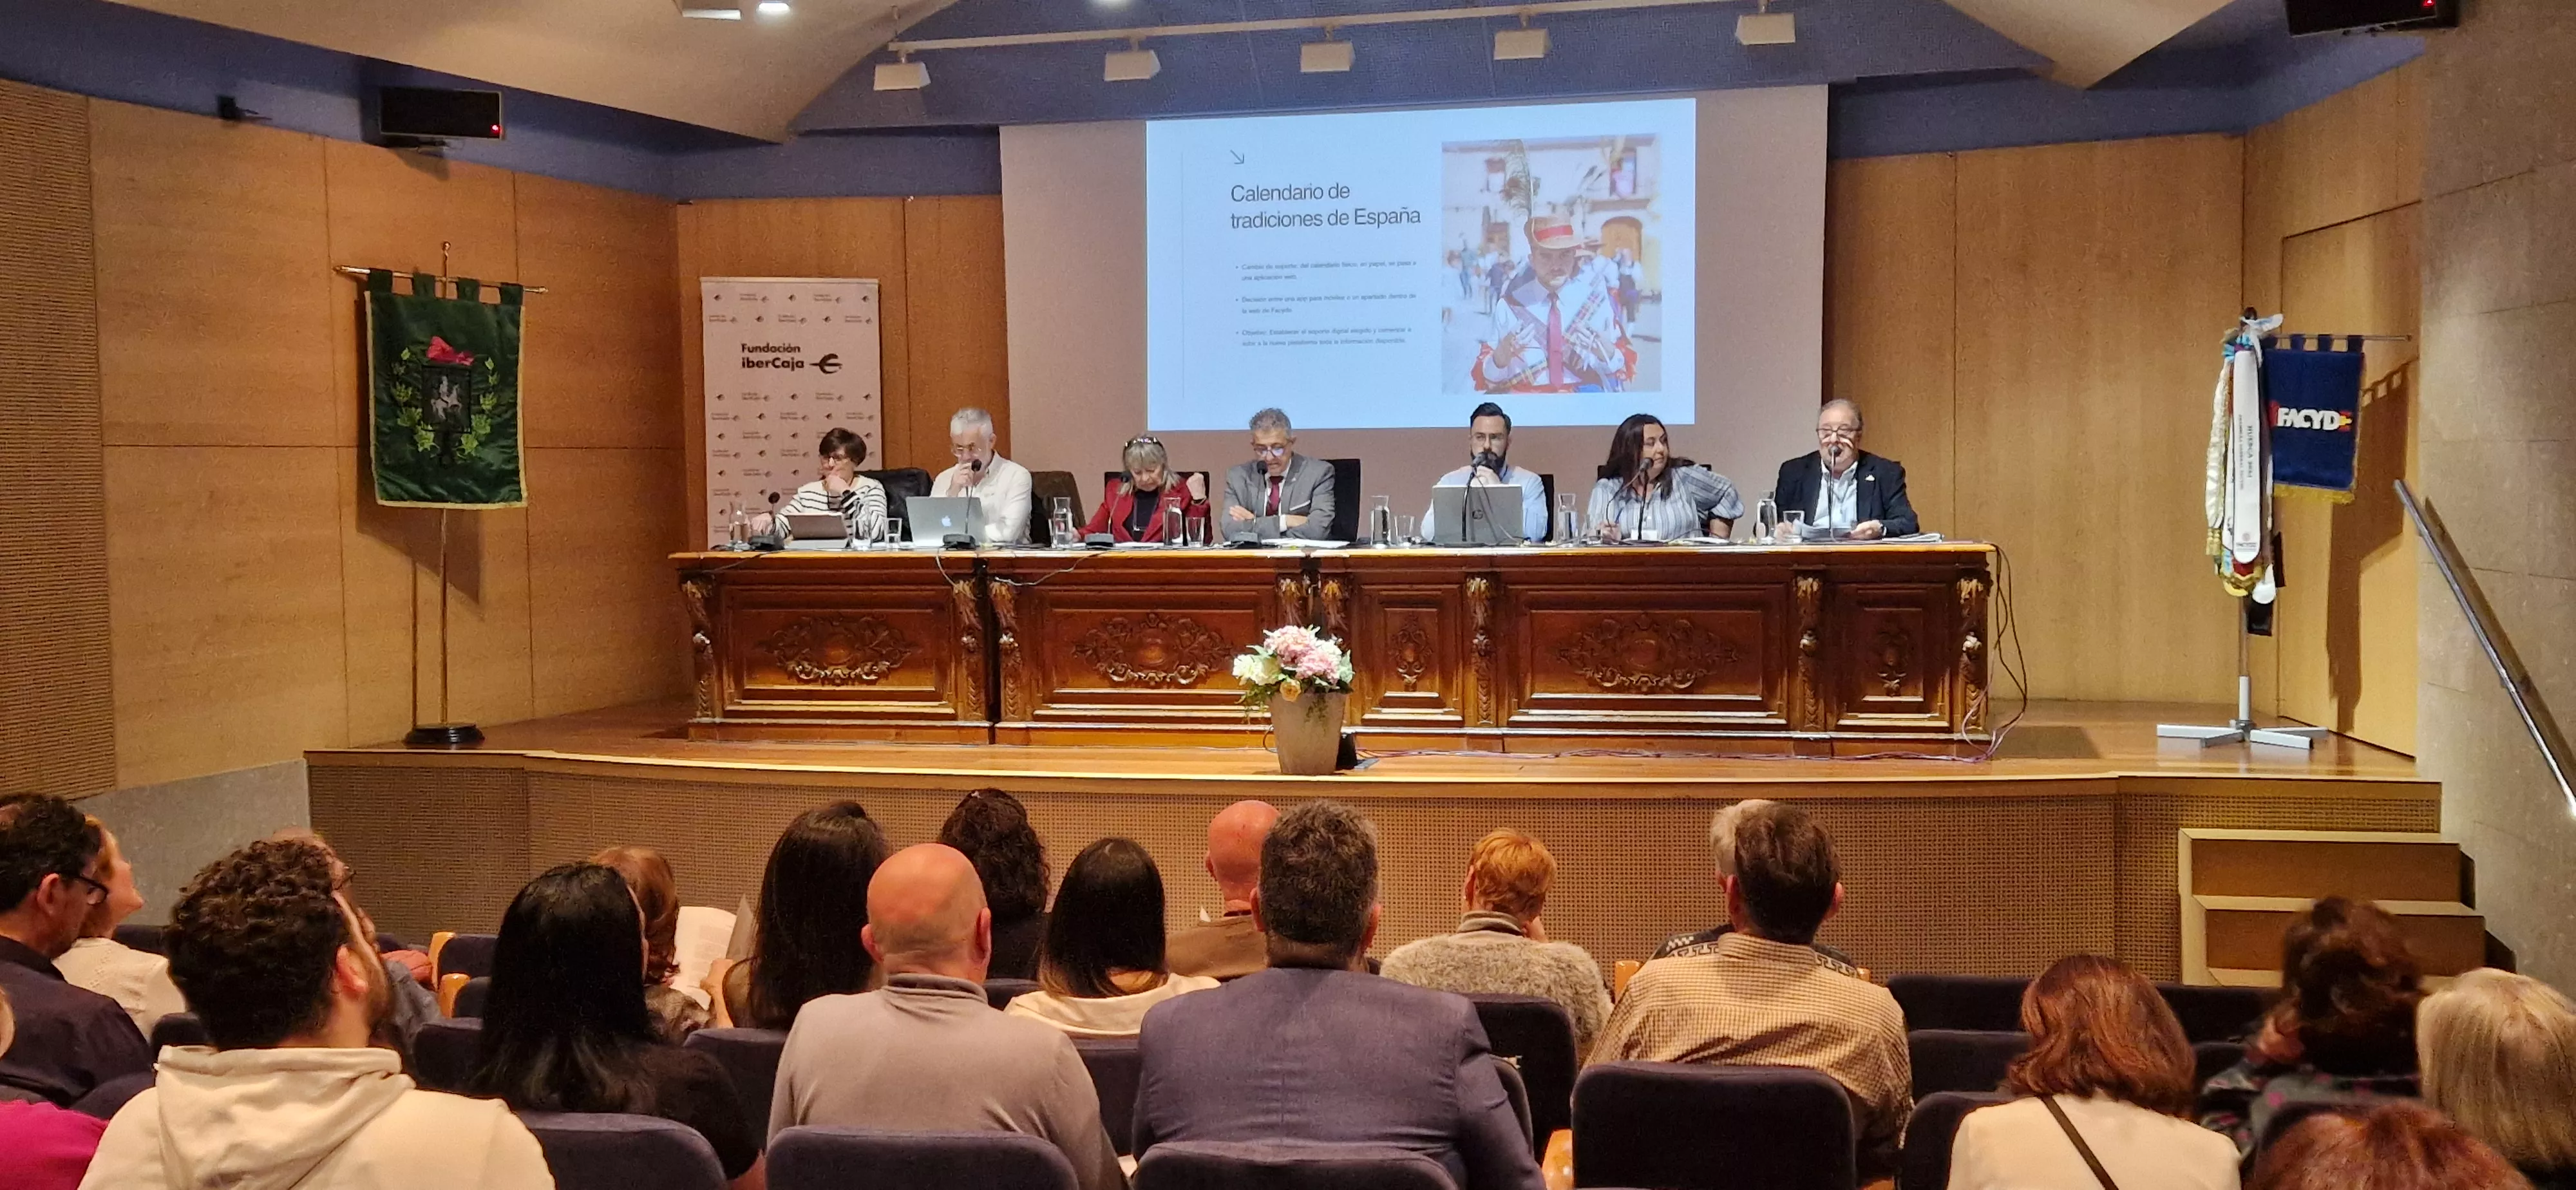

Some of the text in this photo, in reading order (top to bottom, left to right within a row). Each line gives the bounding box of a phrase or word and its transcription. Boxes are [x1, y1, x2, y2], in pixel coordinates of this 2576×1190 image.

[1231, 183, 1350, 202] Calendario de
[1231, 206, 1421, 229] tradiciones de España
[741, 343, 800, 354] Fundación
[742, 357, 804, 372] iberCaja
